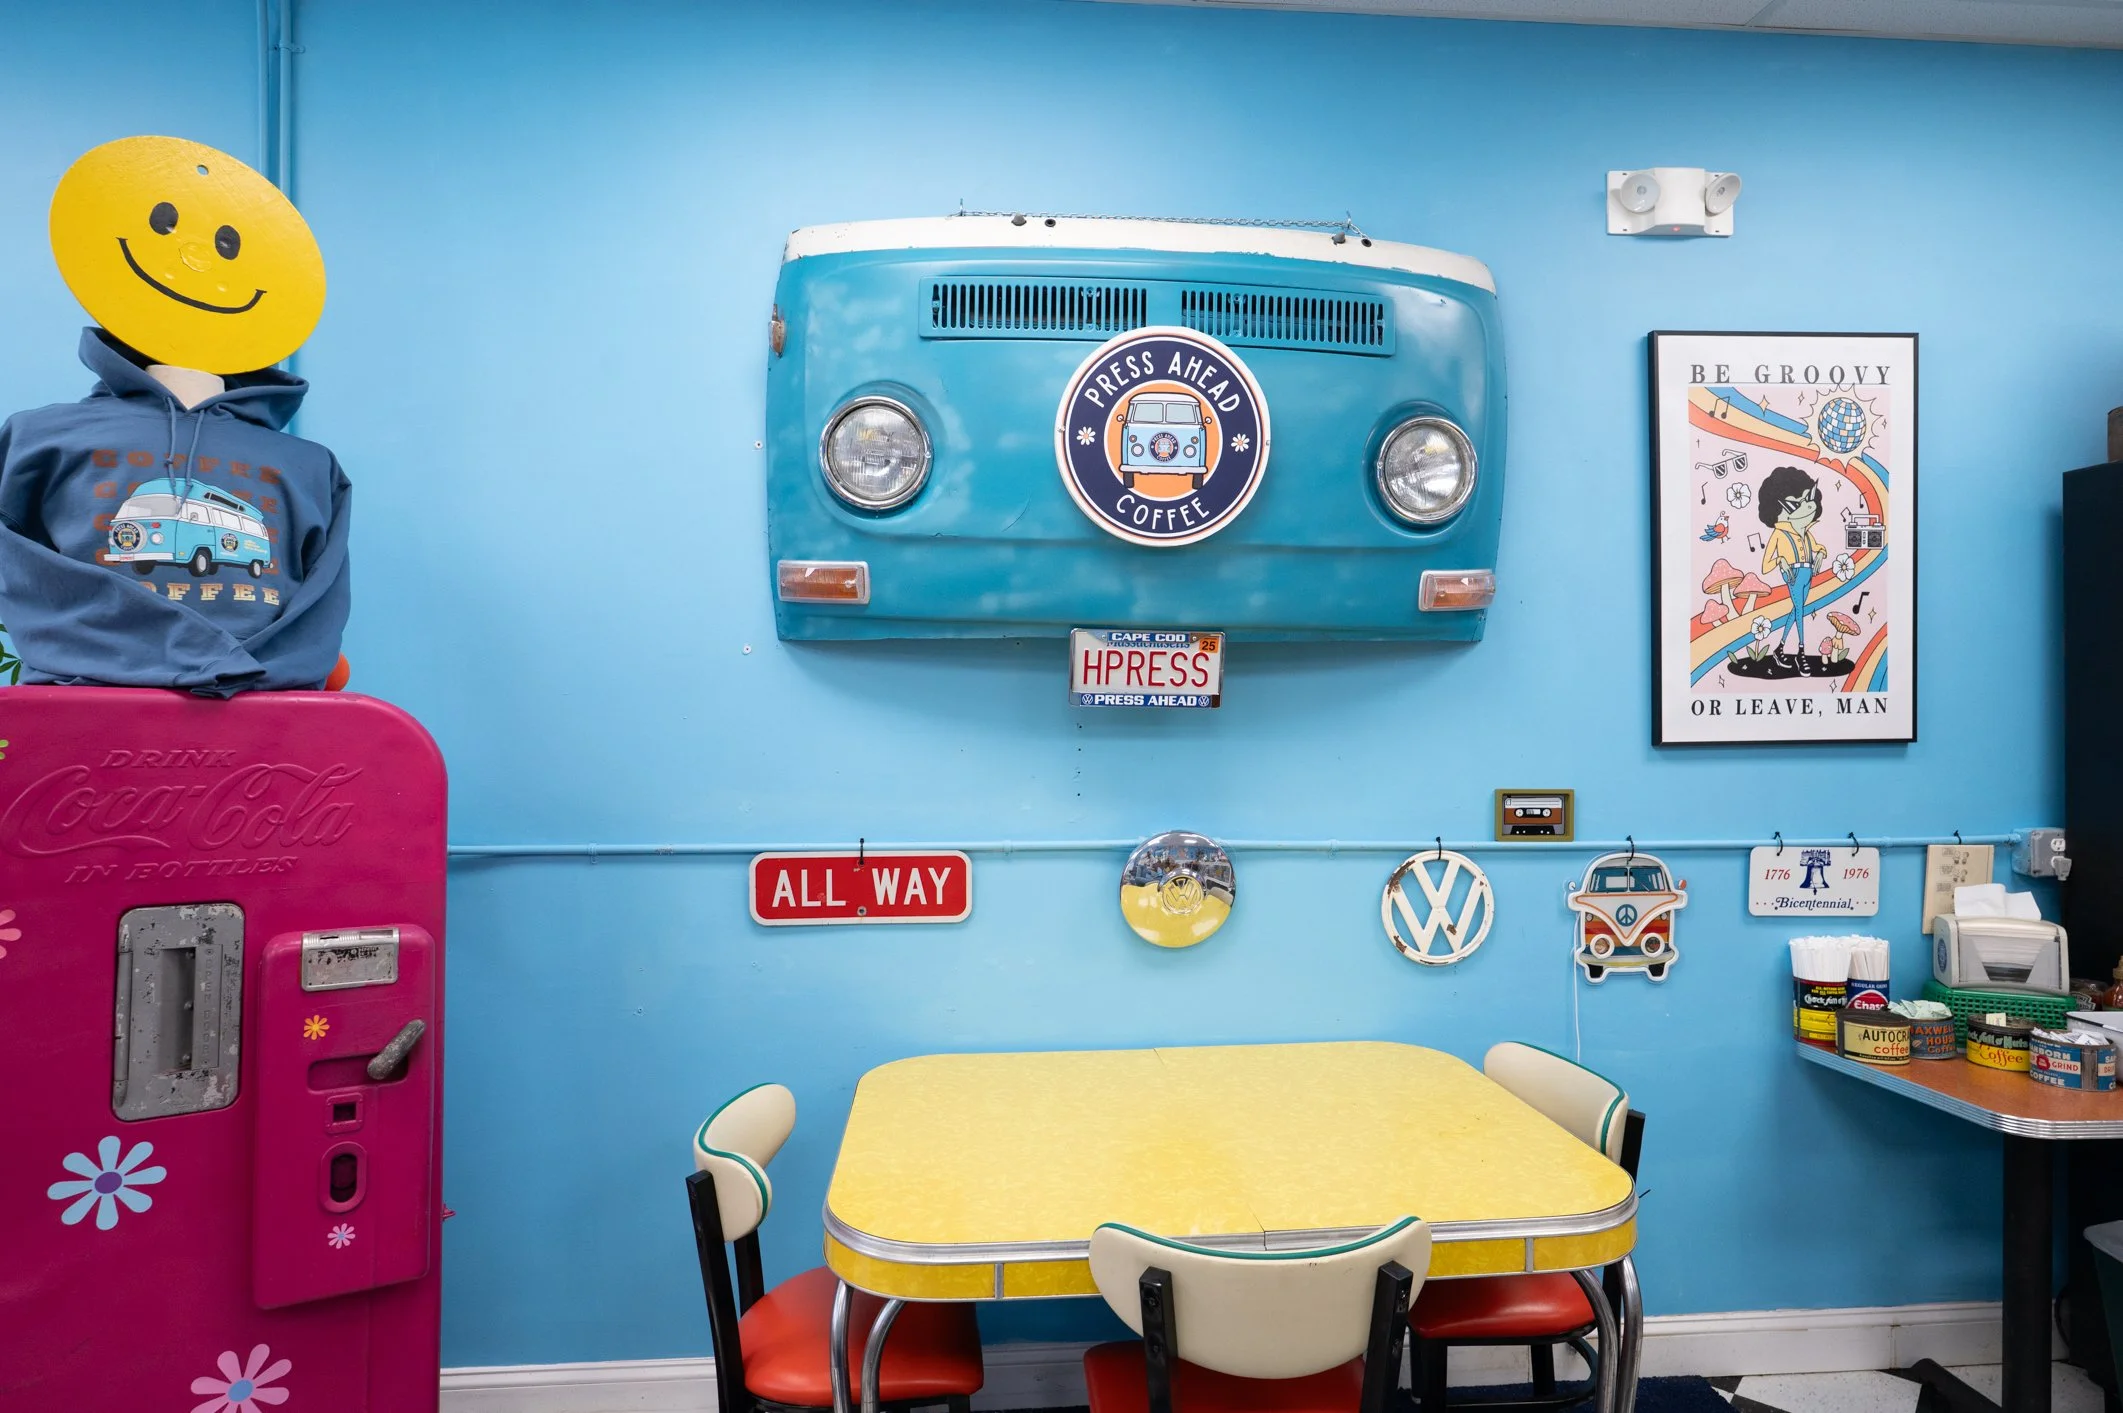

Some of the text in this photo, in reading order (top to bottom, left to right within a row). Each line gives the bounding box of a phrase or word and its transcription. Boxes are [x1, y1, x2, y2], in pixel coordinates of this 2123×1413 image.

[1084, 350, 1241, 412] PRESS AHEAD
[1690, 364, 1891, 385] BE GROOVY
[1115, 494, 1210, 530] COFFEE
[1111, 632, 1187, 643] CAPE COD
[1201, 640, 1216, 652] 25
[1083, 649, 1210, 688] HPRESS
[1094, 694, 1145, 706] PRESS
[1147, 695, 1197, 707] AHEAD
[1691, 697, 1889, 718] OR LEAVE, MAN
[101, 748, 237, 769] DRINK
[64, 855, 300, 884] IN BOTTLES
[1764, 868, 1869, 881] 1776 1976
[771, 867, 952, 908] ALL WAY
[1774, 896, 1854, 911] Bicentennial
[1979, 1043, 2023, 1067] Coffee
[2051, 1061, 2079, 1072] GRIND
